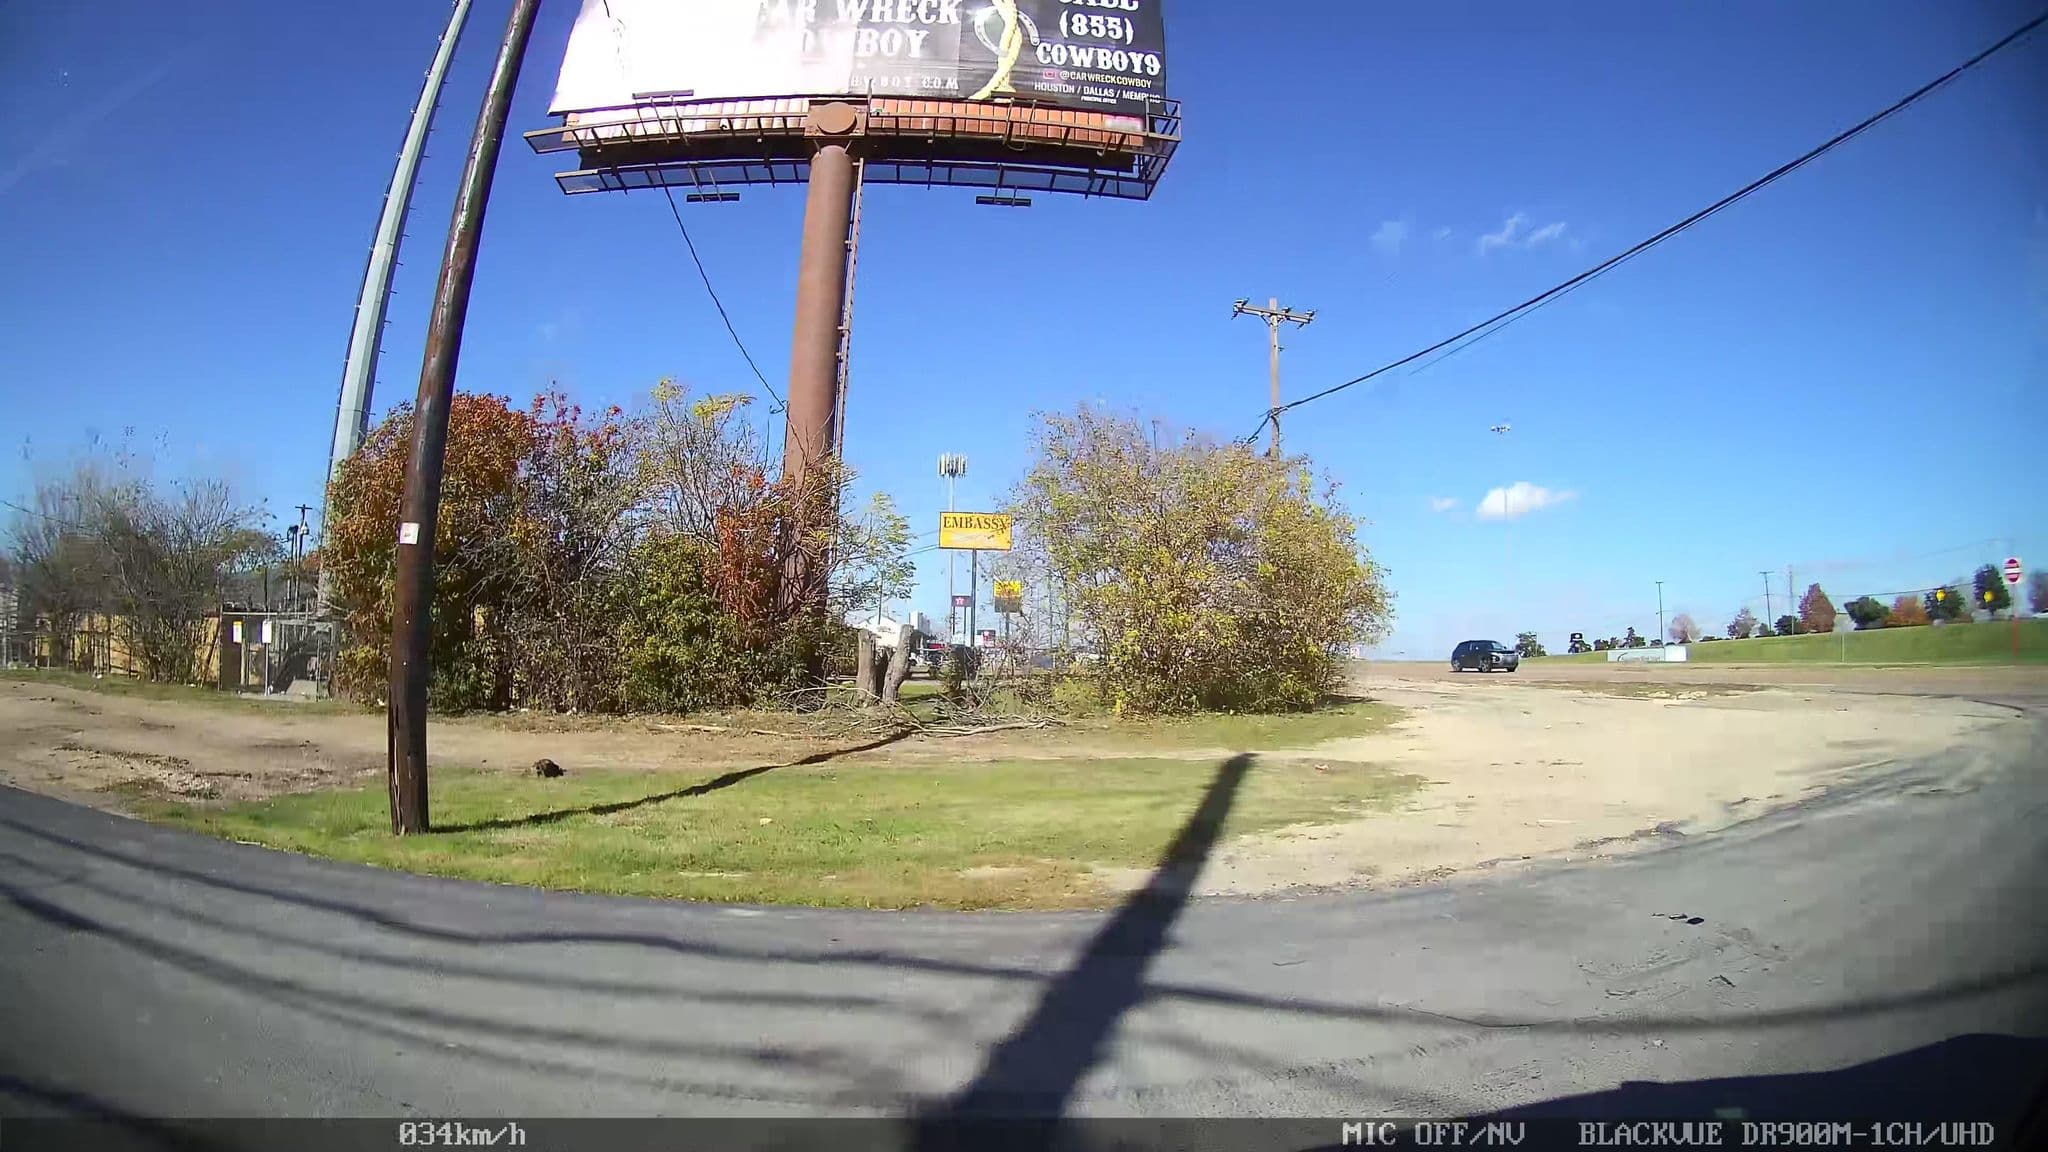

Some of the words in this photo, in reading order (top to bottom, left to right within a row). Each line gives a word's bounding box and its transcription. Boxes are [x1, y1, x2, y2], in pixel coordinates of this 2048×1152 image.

[836, 0, 961, 25] WRECK
[1059, 10, 1134, 45] (855)
[1036, 42, 1161, 76] COWBOY9
[1034, 82, 1075, 94] HOUSTON
[1083, 86, 1115, 98] DALLAS
[1060, 70, 1152, 89] @CARWRECKCOWBOY
[943, 516, 1007, 530] EMBASSY
